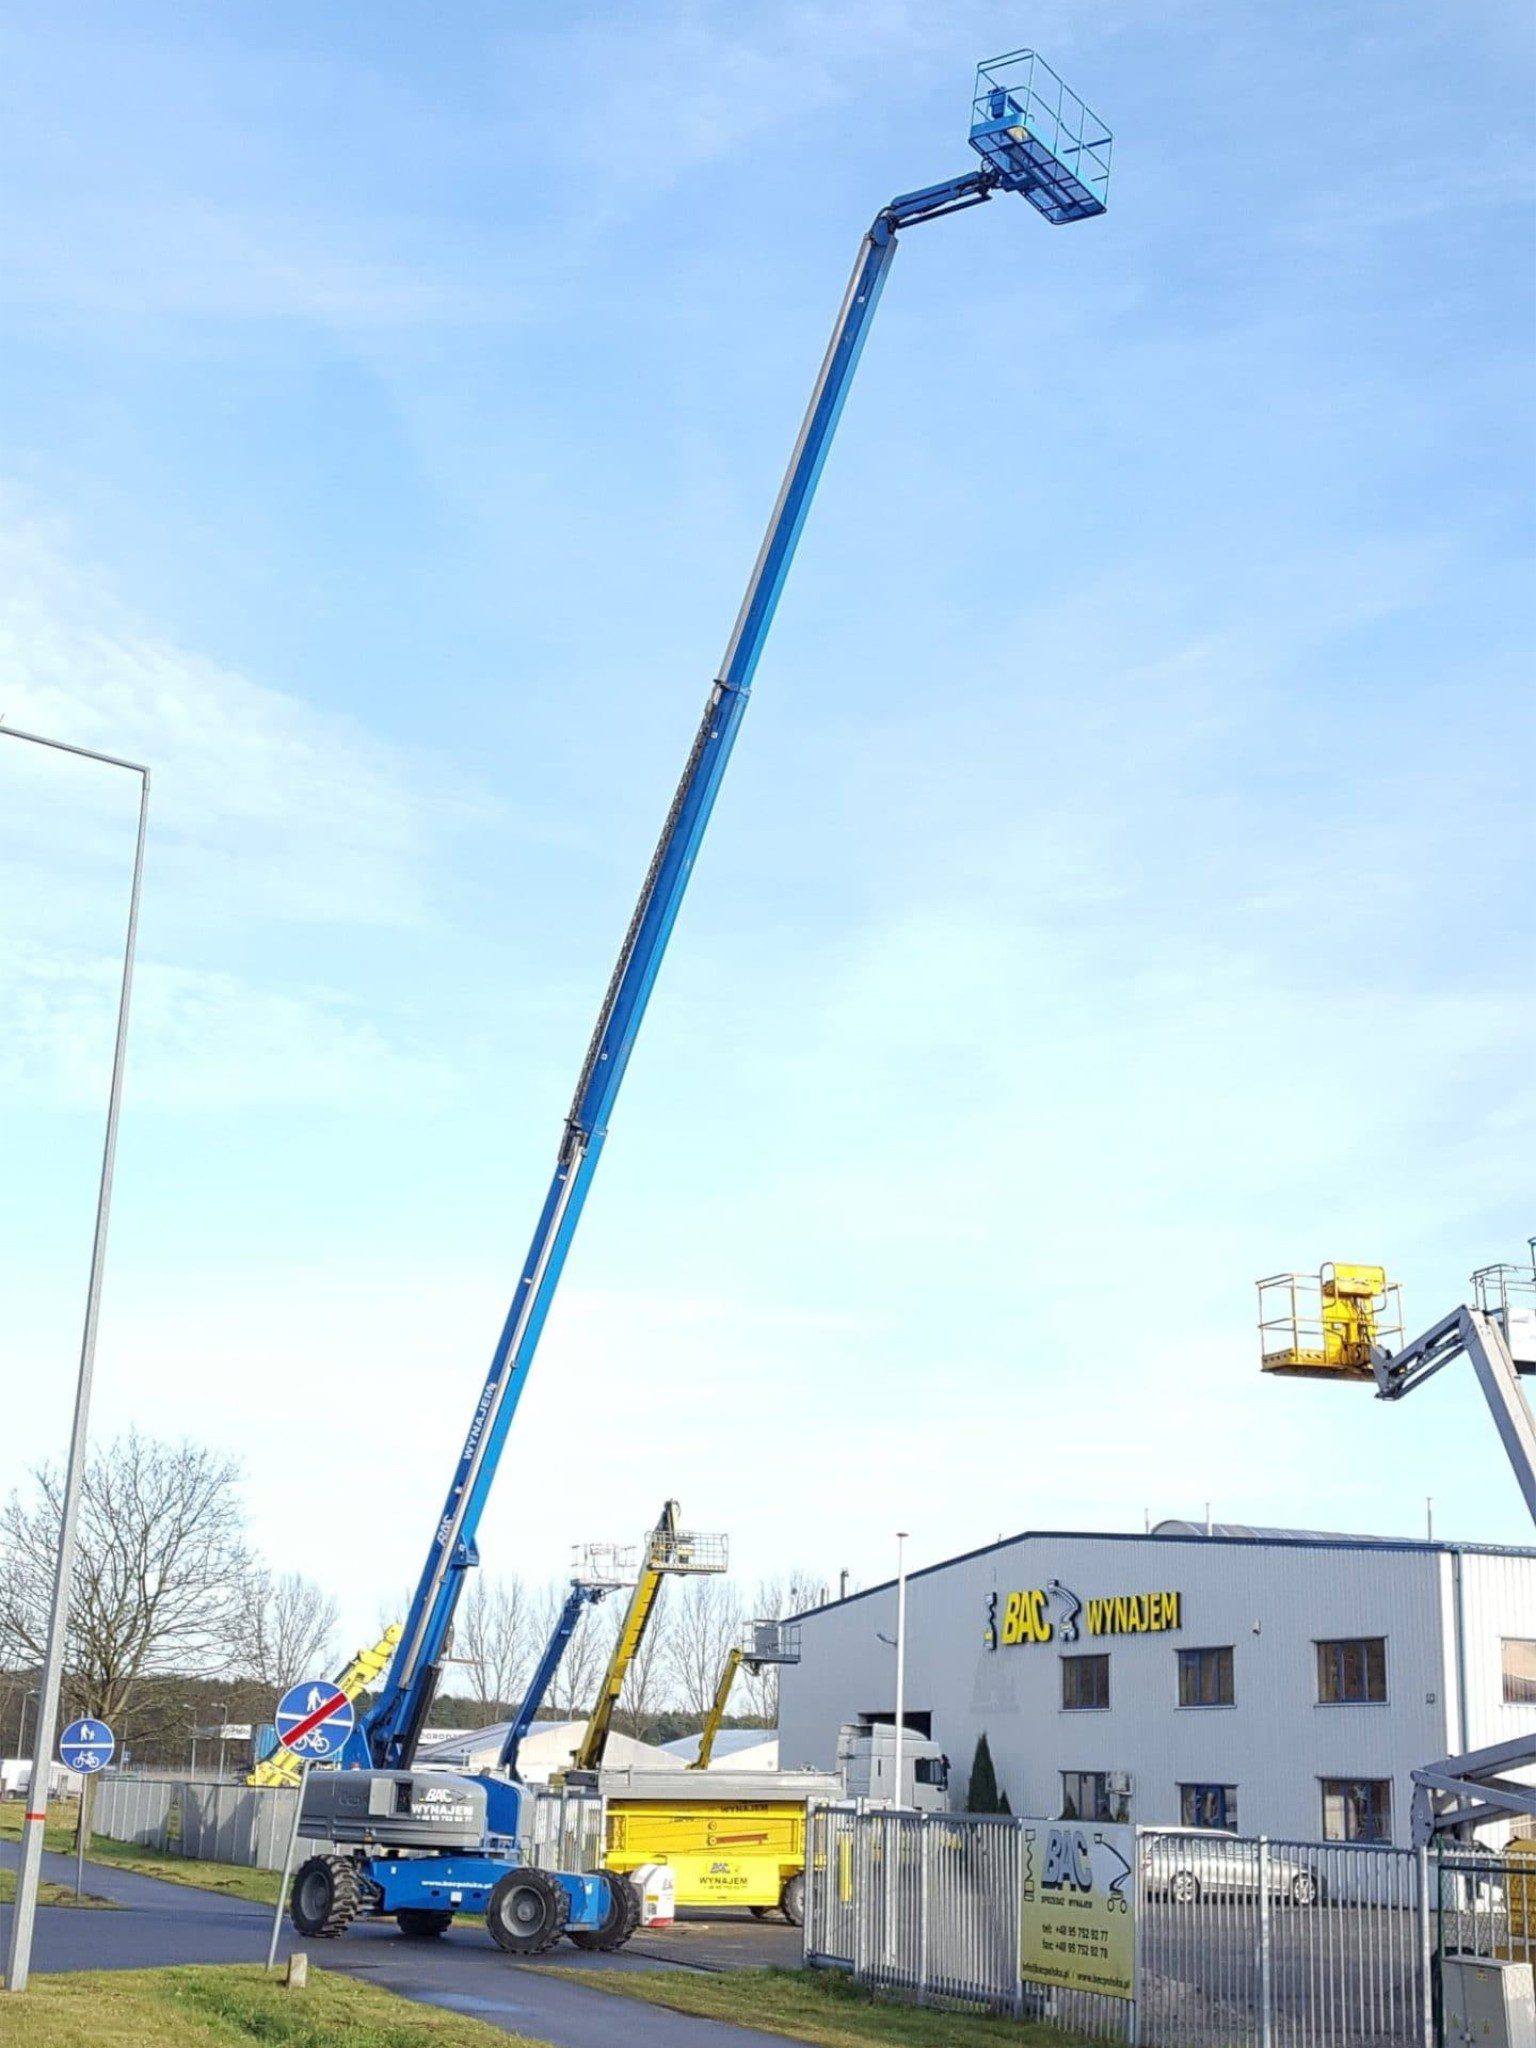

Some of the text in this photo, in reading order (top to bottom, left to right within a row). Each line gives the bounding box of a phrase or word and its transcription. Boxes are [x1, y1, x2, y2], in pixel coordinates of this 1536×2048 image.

[463, 1383, 496, 1460] WYNAJEM
[1001, 1589, 1180, 1645] BAC WYNAJEM
[426, 1788, 453, 1804] BAC
[412, 1804, 473, 1816] WYNAJEM
[1041, 1829, 1093, 1894] BAC
[700, 1877, 748, 1885] WYNAJEM
[1078, 1927, 1090, 1939] 752
[1100, 1930, 1109, 1942] 77
